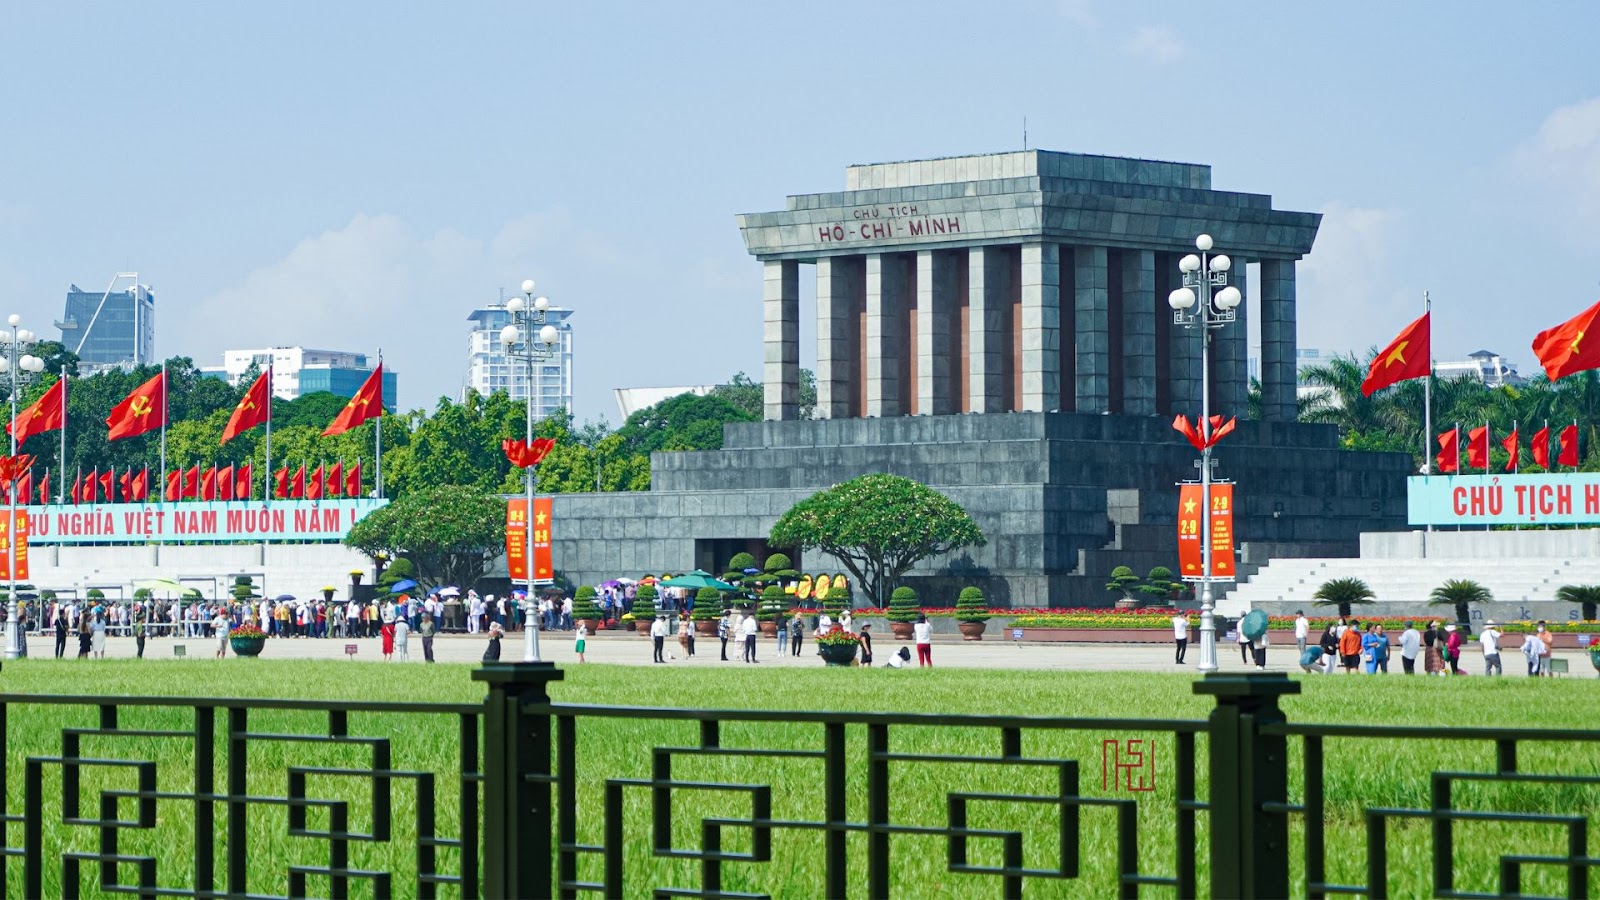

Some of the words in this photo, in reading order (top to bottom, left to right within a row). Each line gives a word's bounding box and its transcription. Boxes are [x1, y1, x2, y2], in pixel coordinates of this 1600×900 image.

[1453, 476, 1503, 516] CHỦ
[1514, 484, 1572, 521] TỊCH
[27, 508, 49, 536] HỦ
[57, 508, 114, 536] NGHĨA
[124, 507, 165, 539] VIỆT
[174, 510, 217, 535] NAM
[226, 505, 285, 534] MUÔN
[294, 504, 340, 533] NĂM
[1180, 520, 1198, 535] 2-9
